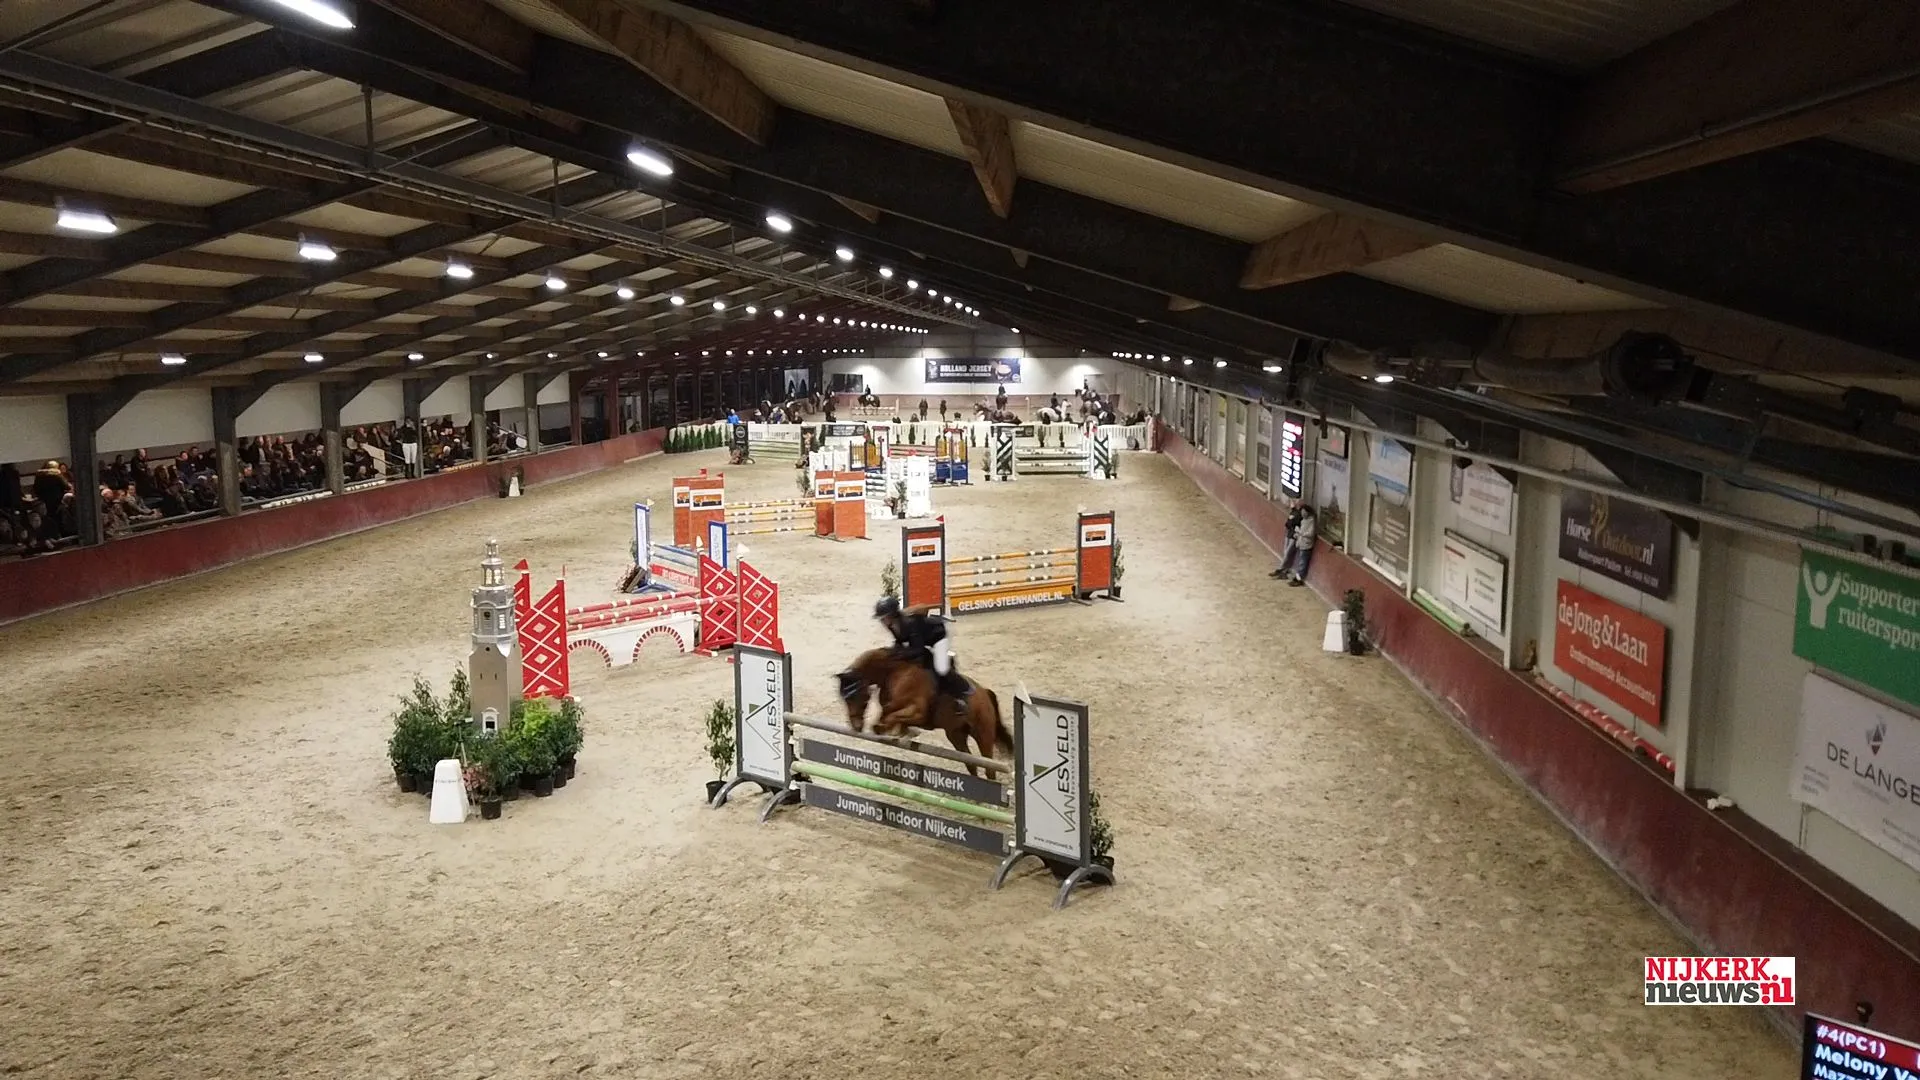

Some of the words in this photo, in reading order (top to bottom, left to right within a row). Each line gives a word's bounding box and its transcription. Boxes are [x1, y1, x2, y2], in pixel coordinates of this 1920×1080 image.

[968, 364, 992, 372] JERSEY
[1566, 517, 1591, 542] Horse
[958, 591, 1065, 612] GELSING-STEENHANDEL.NL
[834, 749, 880, 775] Jumping
[883, 761, 920, 781] Indoor
[923, 770, 965, 793] Nijkerk
[1827, 741, 1850, 770] DE
[1854, 756, 1920, 807] LANGE
[836, 795, 883, 821] Jumping
[886, 807, 923, 831] Indoor
[925, 817, 967, 842] Nijkerk
[1816, 1024, 1886, 1059] #4(PC1)
[1815, 1043, 1888, 1080] Melony
